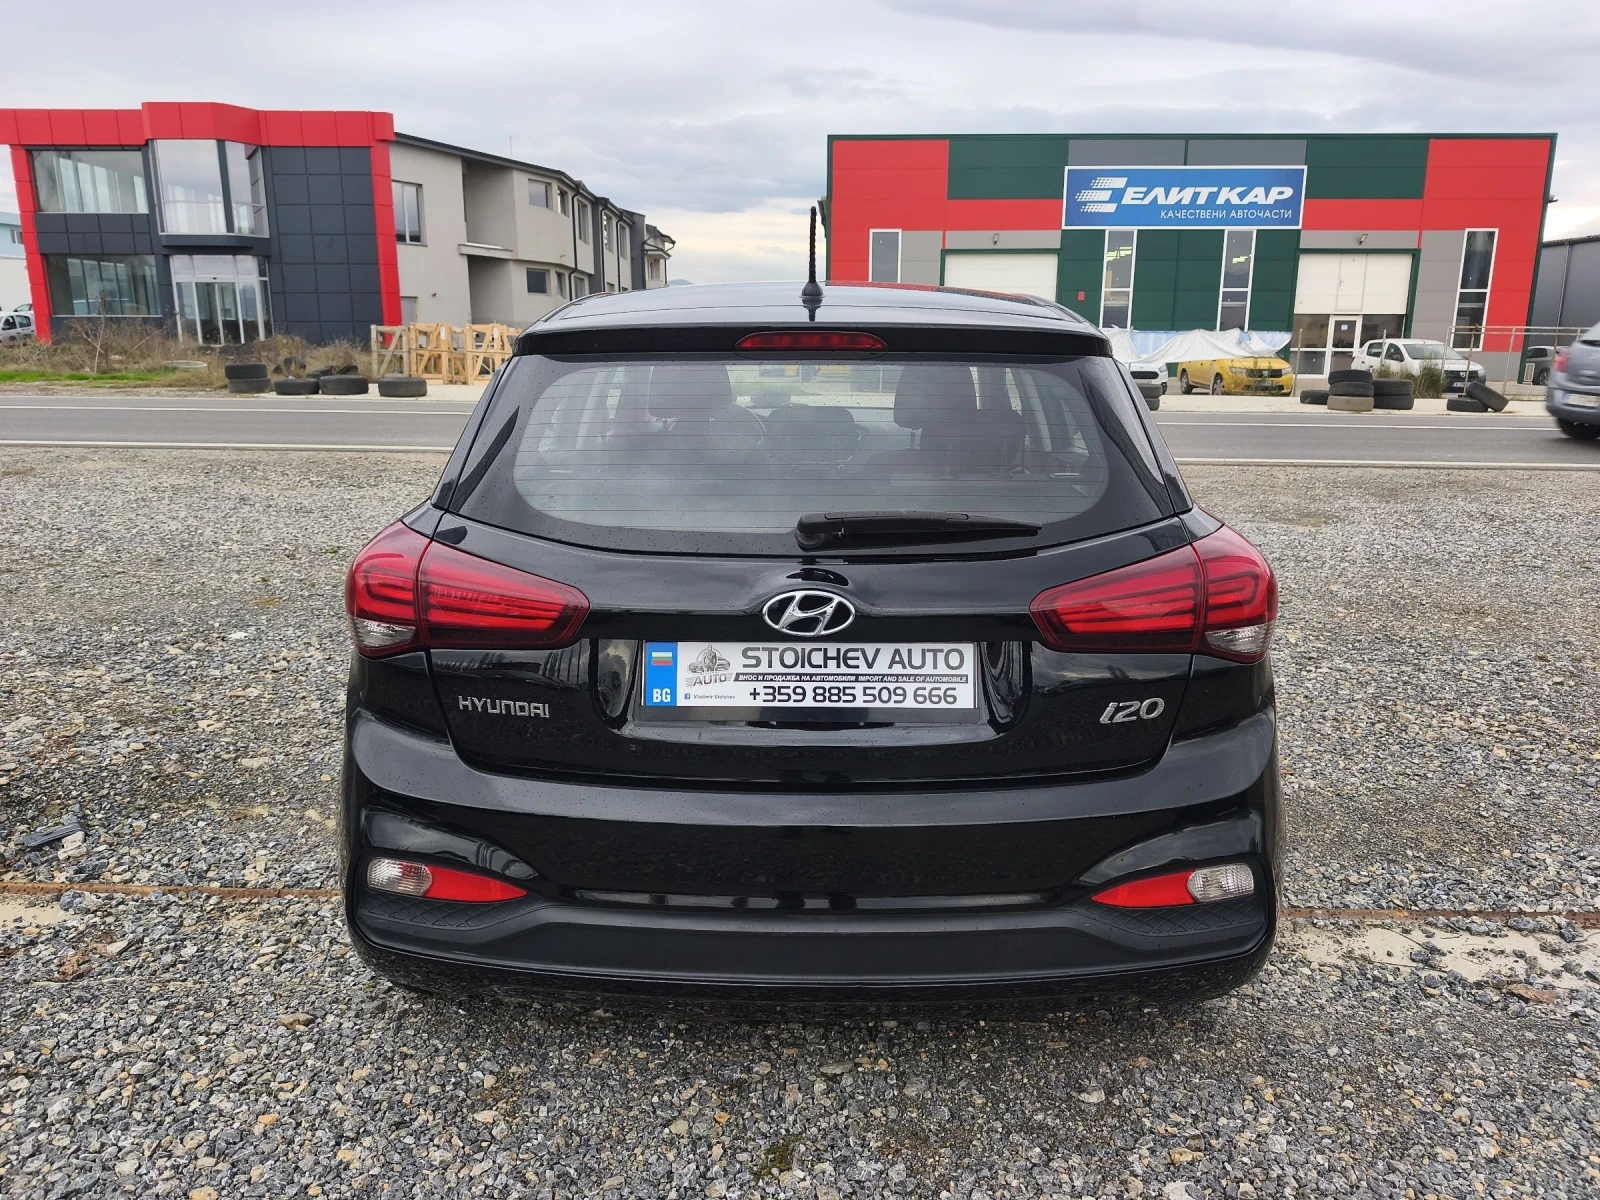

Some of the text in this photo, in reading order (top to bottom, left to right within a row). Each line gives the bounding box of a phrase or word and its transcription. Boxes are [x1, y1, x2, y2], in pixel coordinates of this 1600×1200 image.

[1121, 186, 1294, 205] ЕЛИТ КАР
[1160, 208, 1292, 219] КАЧЕСТВЕНИ АВТОЧАСТИ
[741, 646, 965, 671] STOICHEV AUTO
[692, 672, 727, 687] AUTO
[764, 674, 800, 682] ПРОДАЖБА
[652, 688, 671, 703] BG
[749, 685, 958, 705] +359 885 509 666
[458, 695, 550, 718] HYUNDAI
